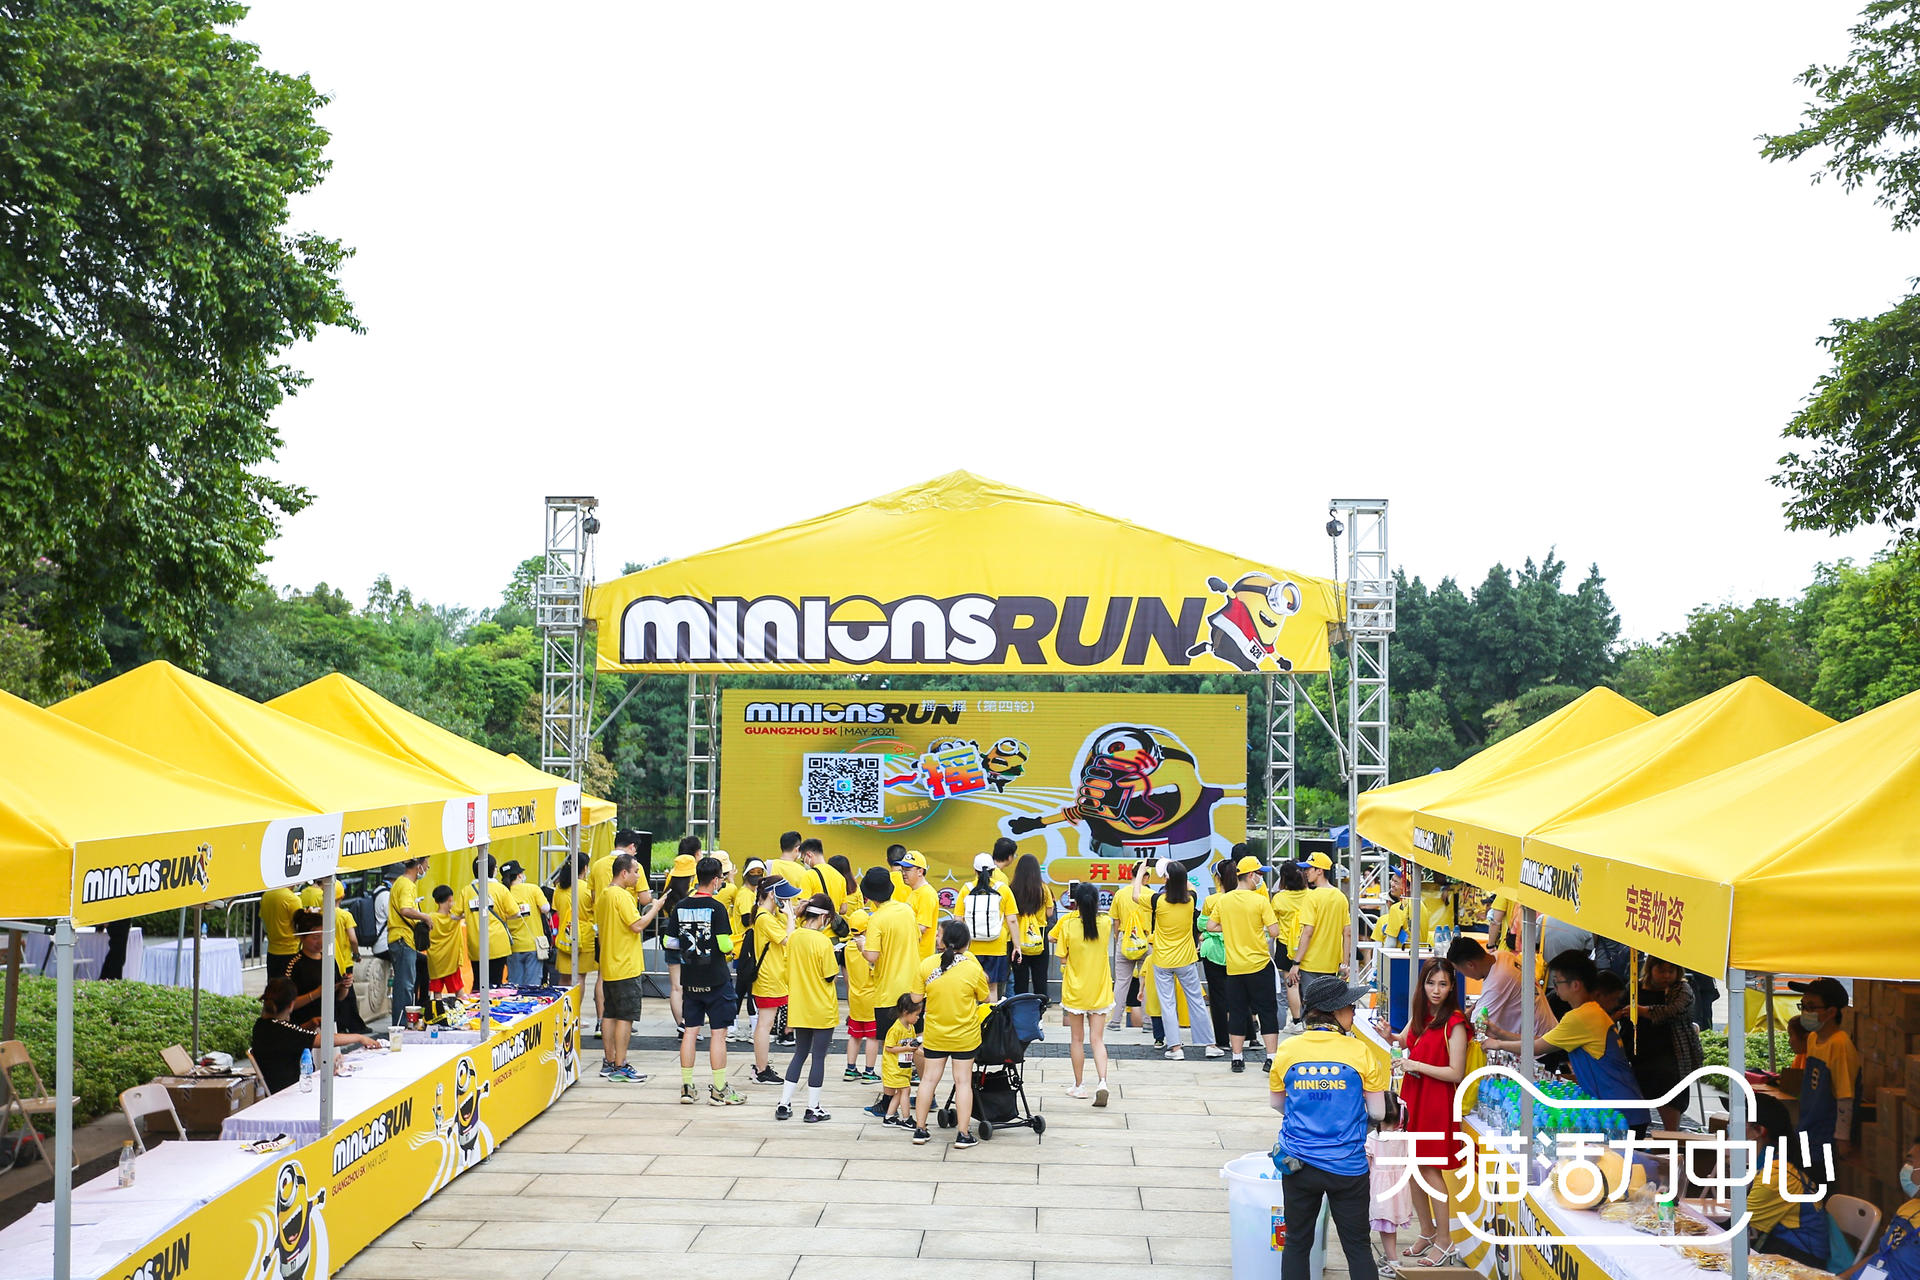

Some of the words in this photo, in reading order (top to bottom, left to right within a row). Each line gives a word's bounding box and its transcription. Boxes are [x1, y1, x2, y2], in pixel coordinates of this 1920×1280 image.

[744, 726, 820, 736] GUANGZHOU
[822, 726, 838, 736] 5K
[844, 727, 869, 737] MAY
[872, 727, 895, 737] 2021
[287, 852, 302, 867] TIME
[1475, 842, 1505, 884] 完赛补给
[1625, 884, 1685, 946] 完赛物资
[1293, 1078, 1347, 1091] MINIONS
[1308, 1091, 1332, 1101] RUN
